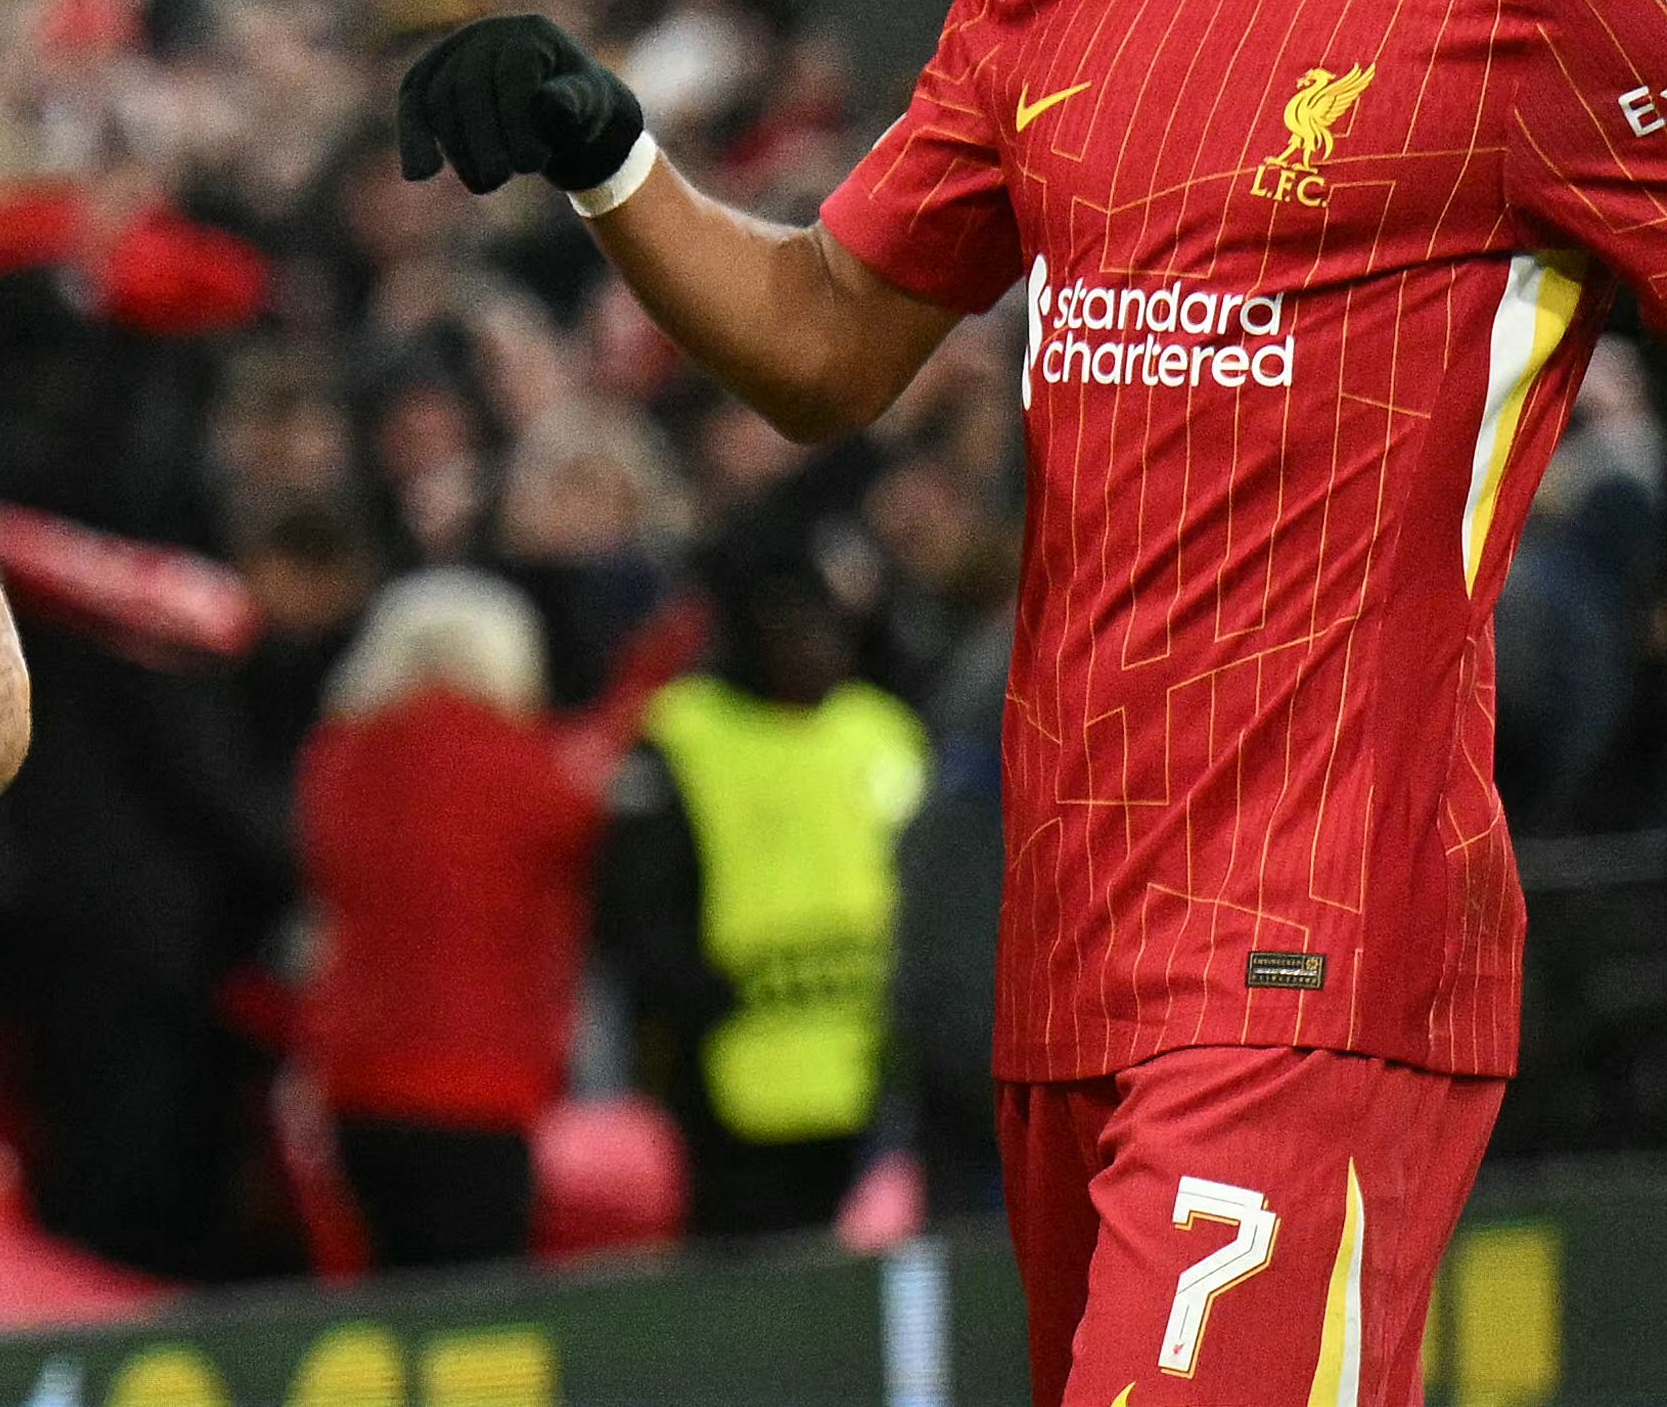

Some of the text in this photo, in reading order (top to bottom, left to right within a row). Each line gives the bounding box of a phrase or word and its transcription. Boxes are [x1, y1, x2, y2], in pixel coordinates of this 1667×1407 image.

[1250, 165, 1327, 208] L.F.C.
[1052, 276, 1285, 336] standard
[1042, 331, 1295, 388] chartered
[1158, 1175, 1282, 1380] 7
